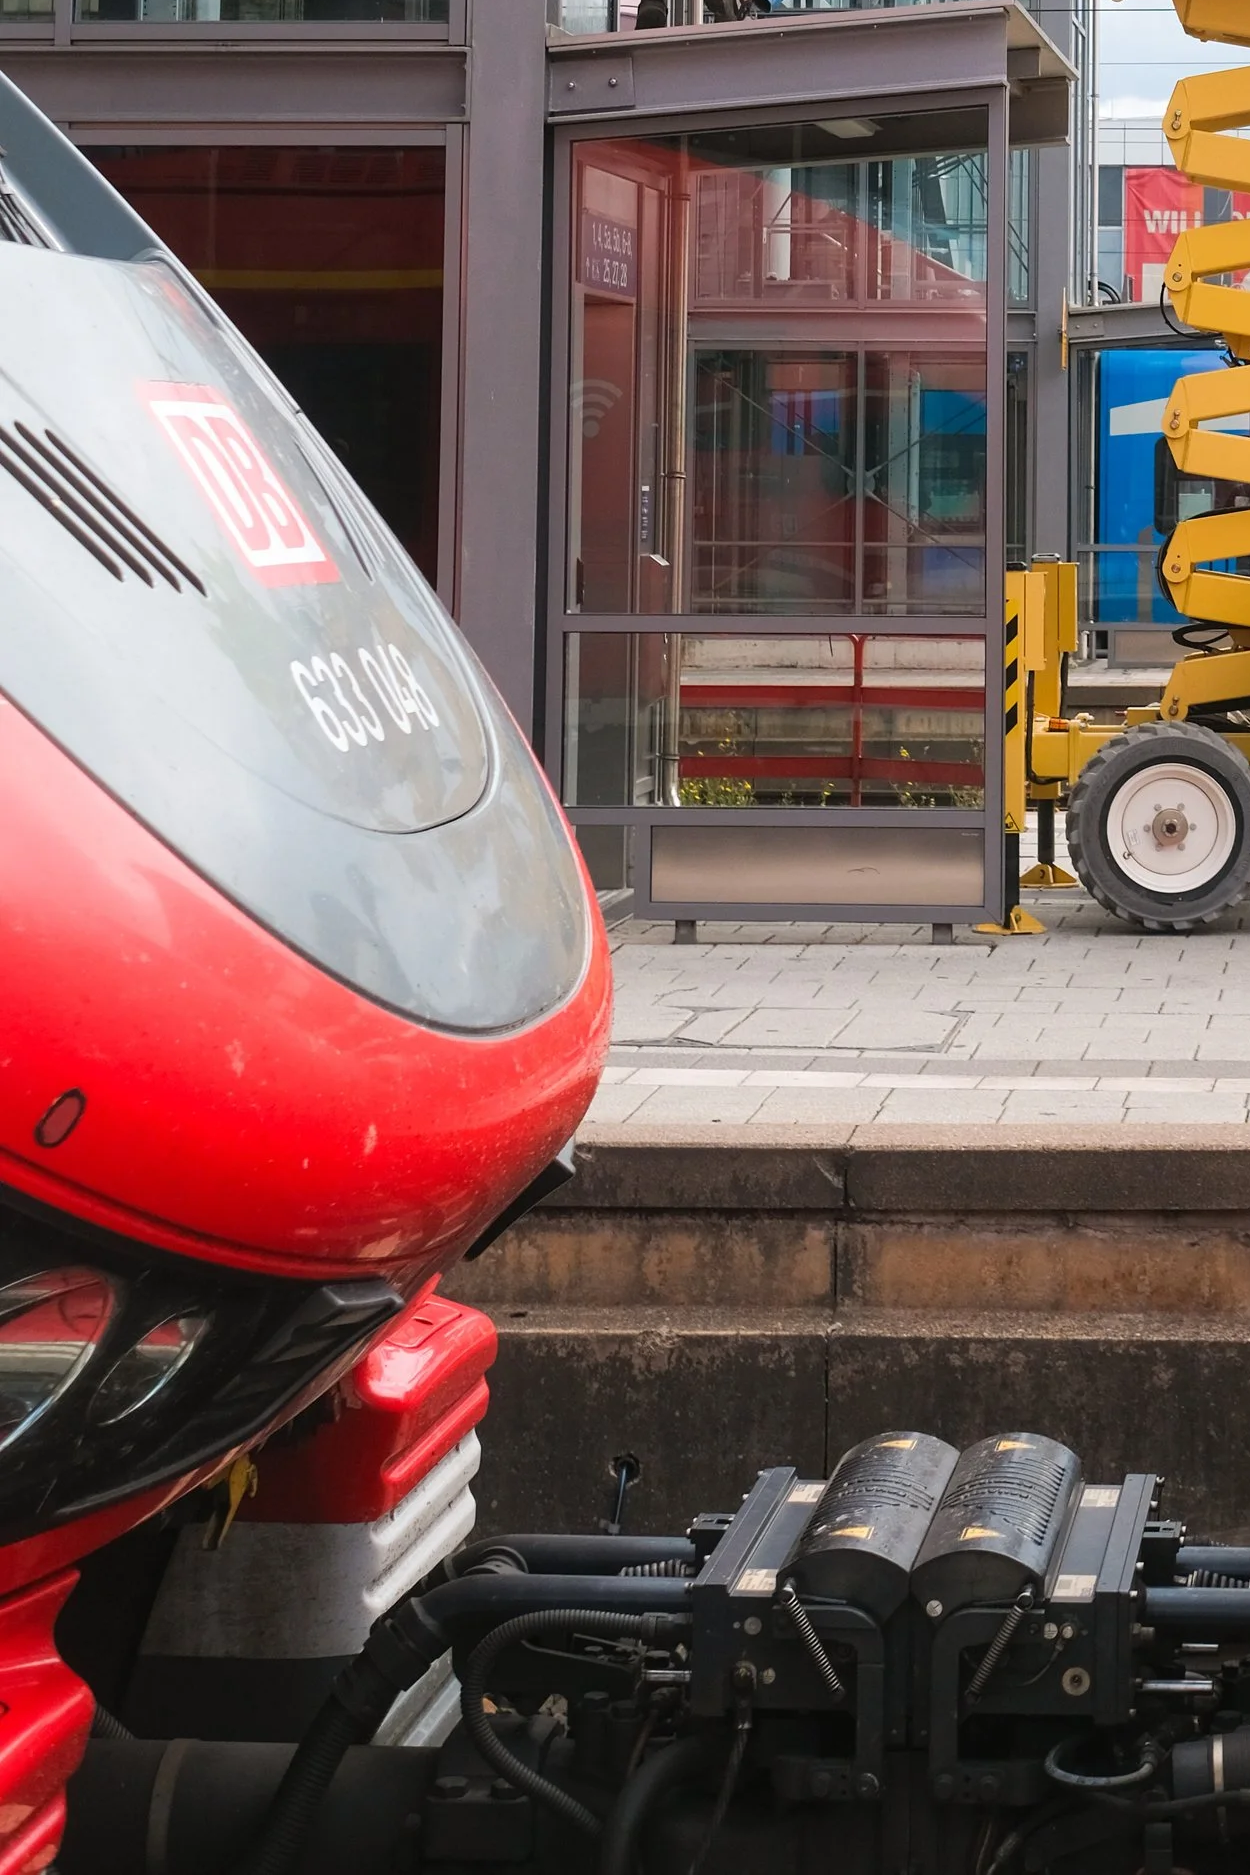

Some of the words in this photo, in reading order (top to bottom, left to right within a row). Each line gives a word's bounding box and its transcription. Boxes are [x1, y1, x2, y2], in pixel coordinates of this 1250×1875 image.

[165, 414, 307, 552] DB
[290, 660, 385, 752] 633
[357, 643, 440, 734] 048
